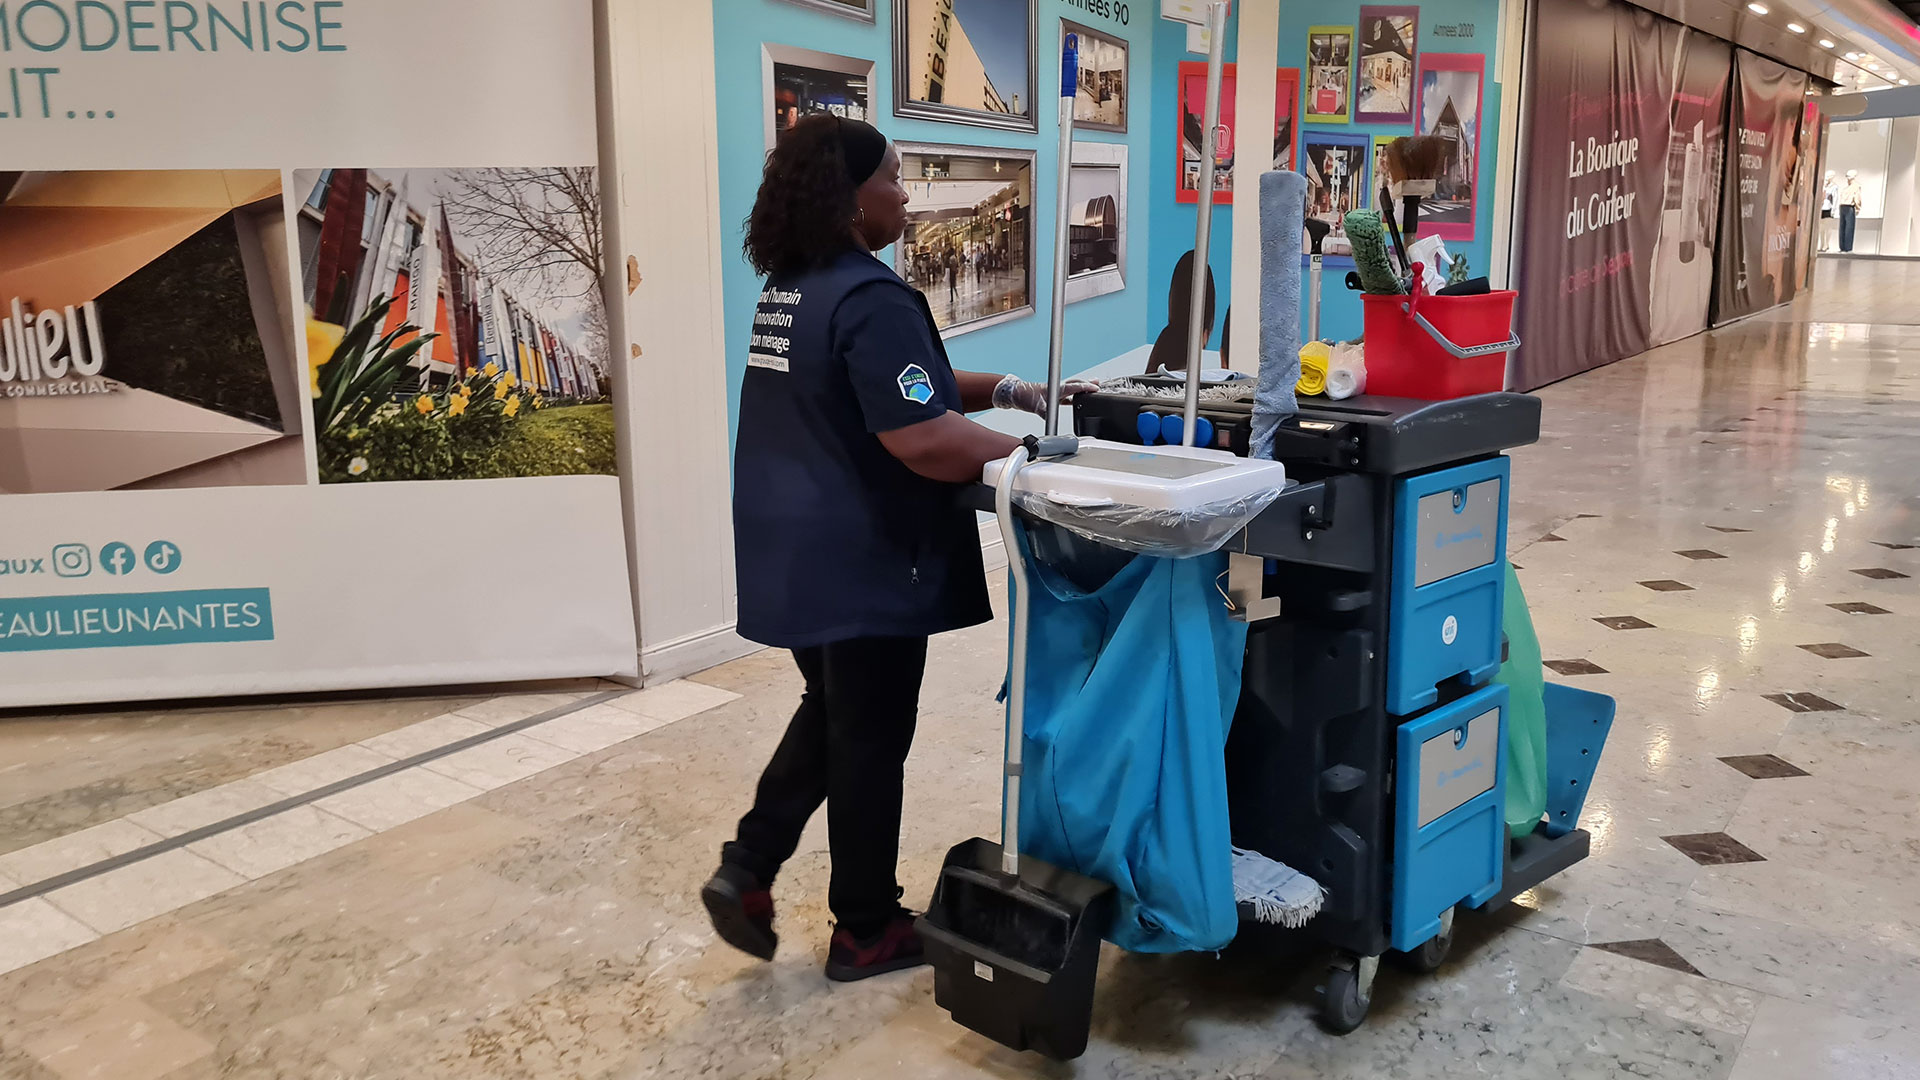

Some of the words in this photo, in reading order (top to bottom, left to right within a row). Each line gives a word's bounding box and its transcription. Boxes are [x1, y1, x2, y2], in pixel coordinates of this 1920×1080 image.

[0, 0, 347, 52] ODERNISE
[1113, 0, 1130, 26] 90
[1569, 141, 1584, 178] La
[1587, 129, 1639, 177] Bouique
[1567, 196, 1585, 239] du
[409, 257, 421, 311] MANGO
[484, 303, 496, 345] Bershka
[6, 380, 111, 398] COMMERCIAL
